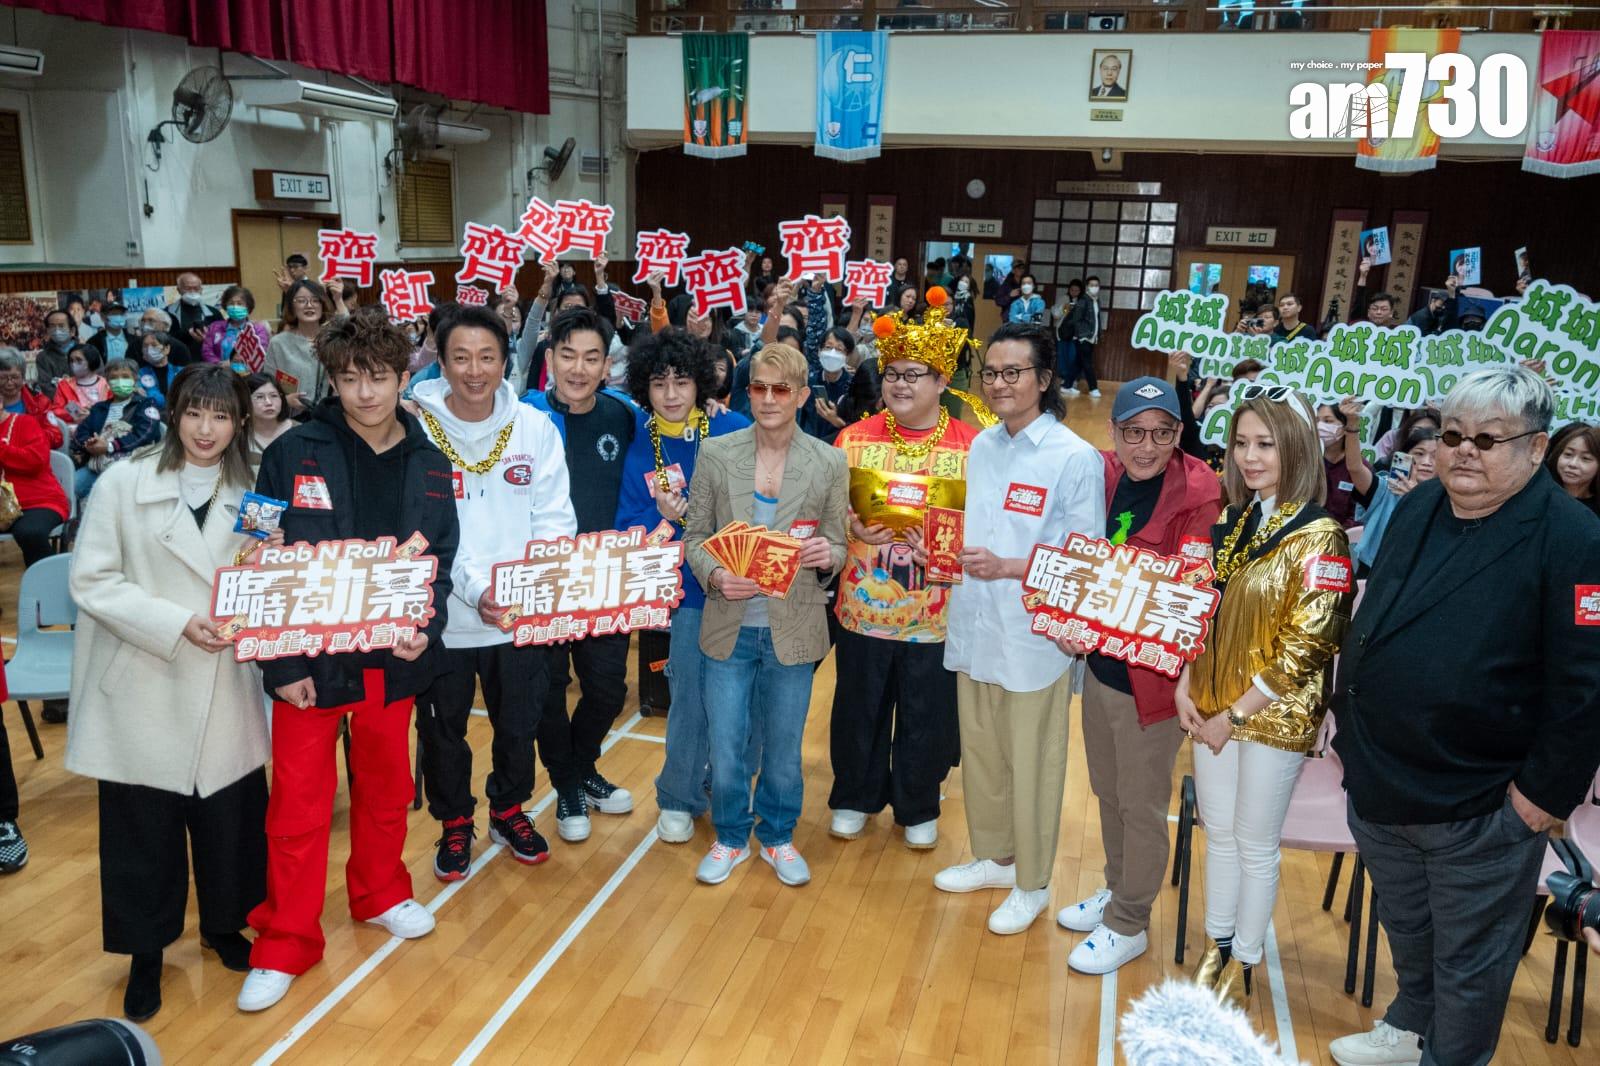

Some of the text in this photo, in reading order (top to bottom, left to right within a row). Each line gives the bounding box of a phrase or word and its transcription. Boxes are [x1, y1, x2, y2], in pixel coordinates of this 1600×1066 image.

[280, 178, 323, 194] EXIT 出口
[556, 202, 612, 258] 齊
[780, 218, 846, 284] 齊
[948, 222, 995, 234] EXIT 出口
[1215, 231, 1268, 243] EXIT 出口
[320, 229, 377, 286] 齊
[458, 224, 525, 291] 齊
[633, 232, 688, 286] 齊
[682, 250, 745, 317] 齊
[846, 261, 891, 308] 齊
[1156, 293, 1224, 329] 城城
[1135, 317, 1228, 357] Aaron
[1329, 326, 1416, 370] 城城
[1485, 309, 1600, 389] Aaron
[1305, 357, 1421, 404] Aaron
[260, 541, 391, 565] Rob N Roll
[529, 531, 642, 559] Rob N Roll
[1068, 536, 1180, 578] Rob N Roll
[215, 559, 434, 628] 臨時劫案
[495, 545, 681, 616] 臨時劫案
[1025, 548, 1216, 643] 臨時劫案
